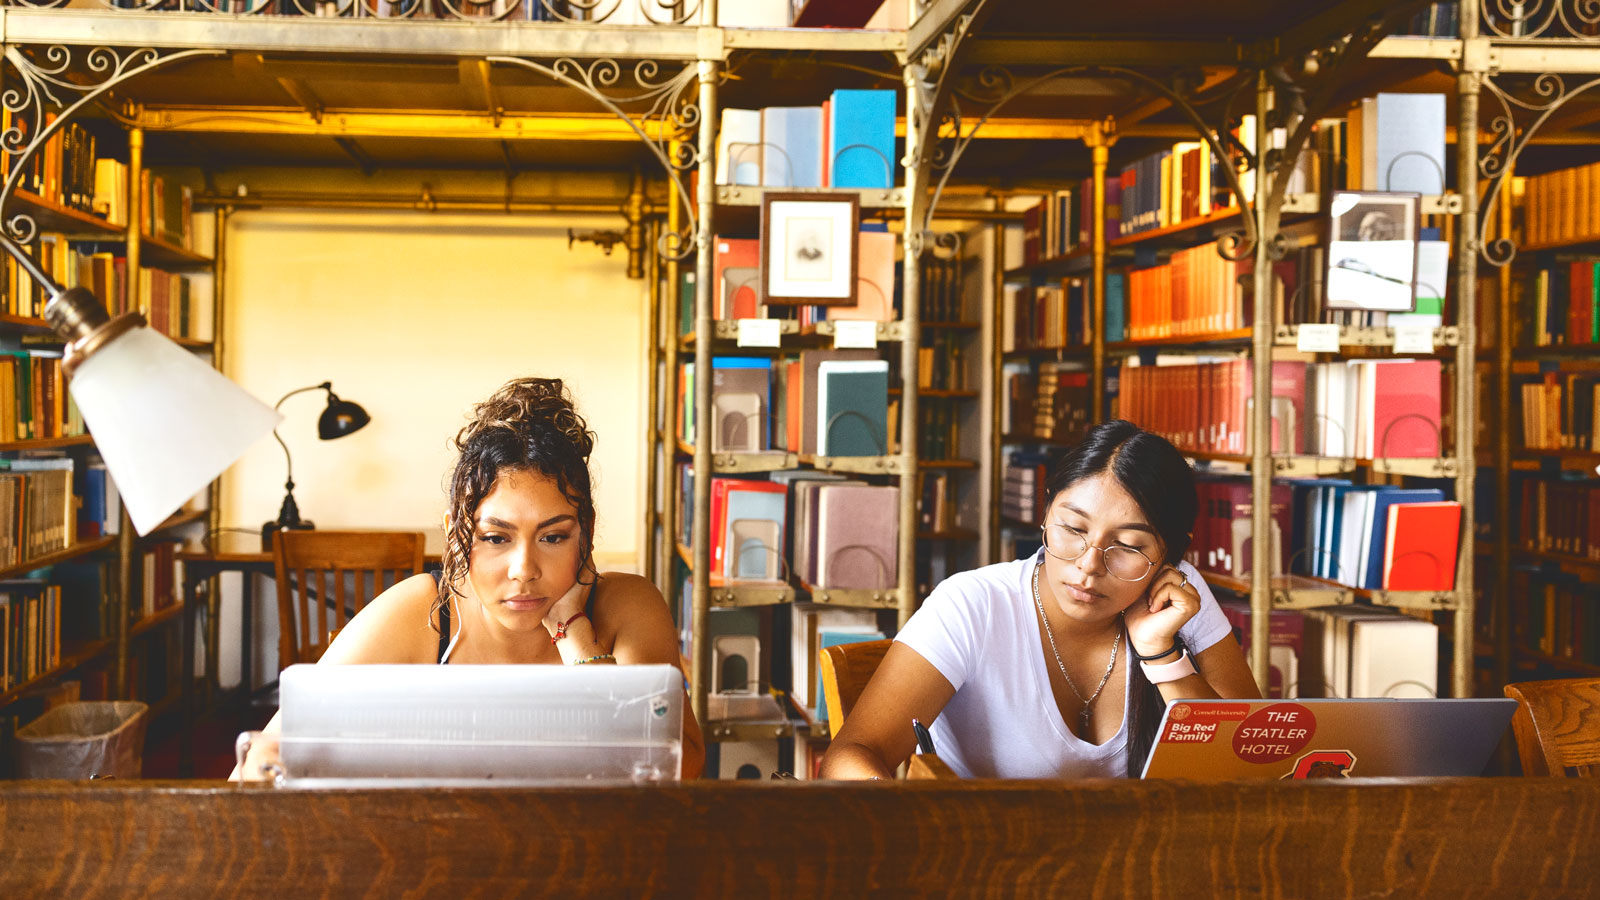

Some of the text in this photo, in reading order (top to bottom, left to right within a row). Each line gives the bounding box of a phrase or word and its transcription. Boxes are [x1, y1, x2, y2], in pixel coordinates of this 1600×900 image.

[1267, 711, 1299, 723] THE
[1171, 723, 1217, 733] Big Red
[1240, 727, 1307, 739] STATLER
[1168, 732, 1212, 743] Family
[1240, 744, 1291, 755] HOTEL
